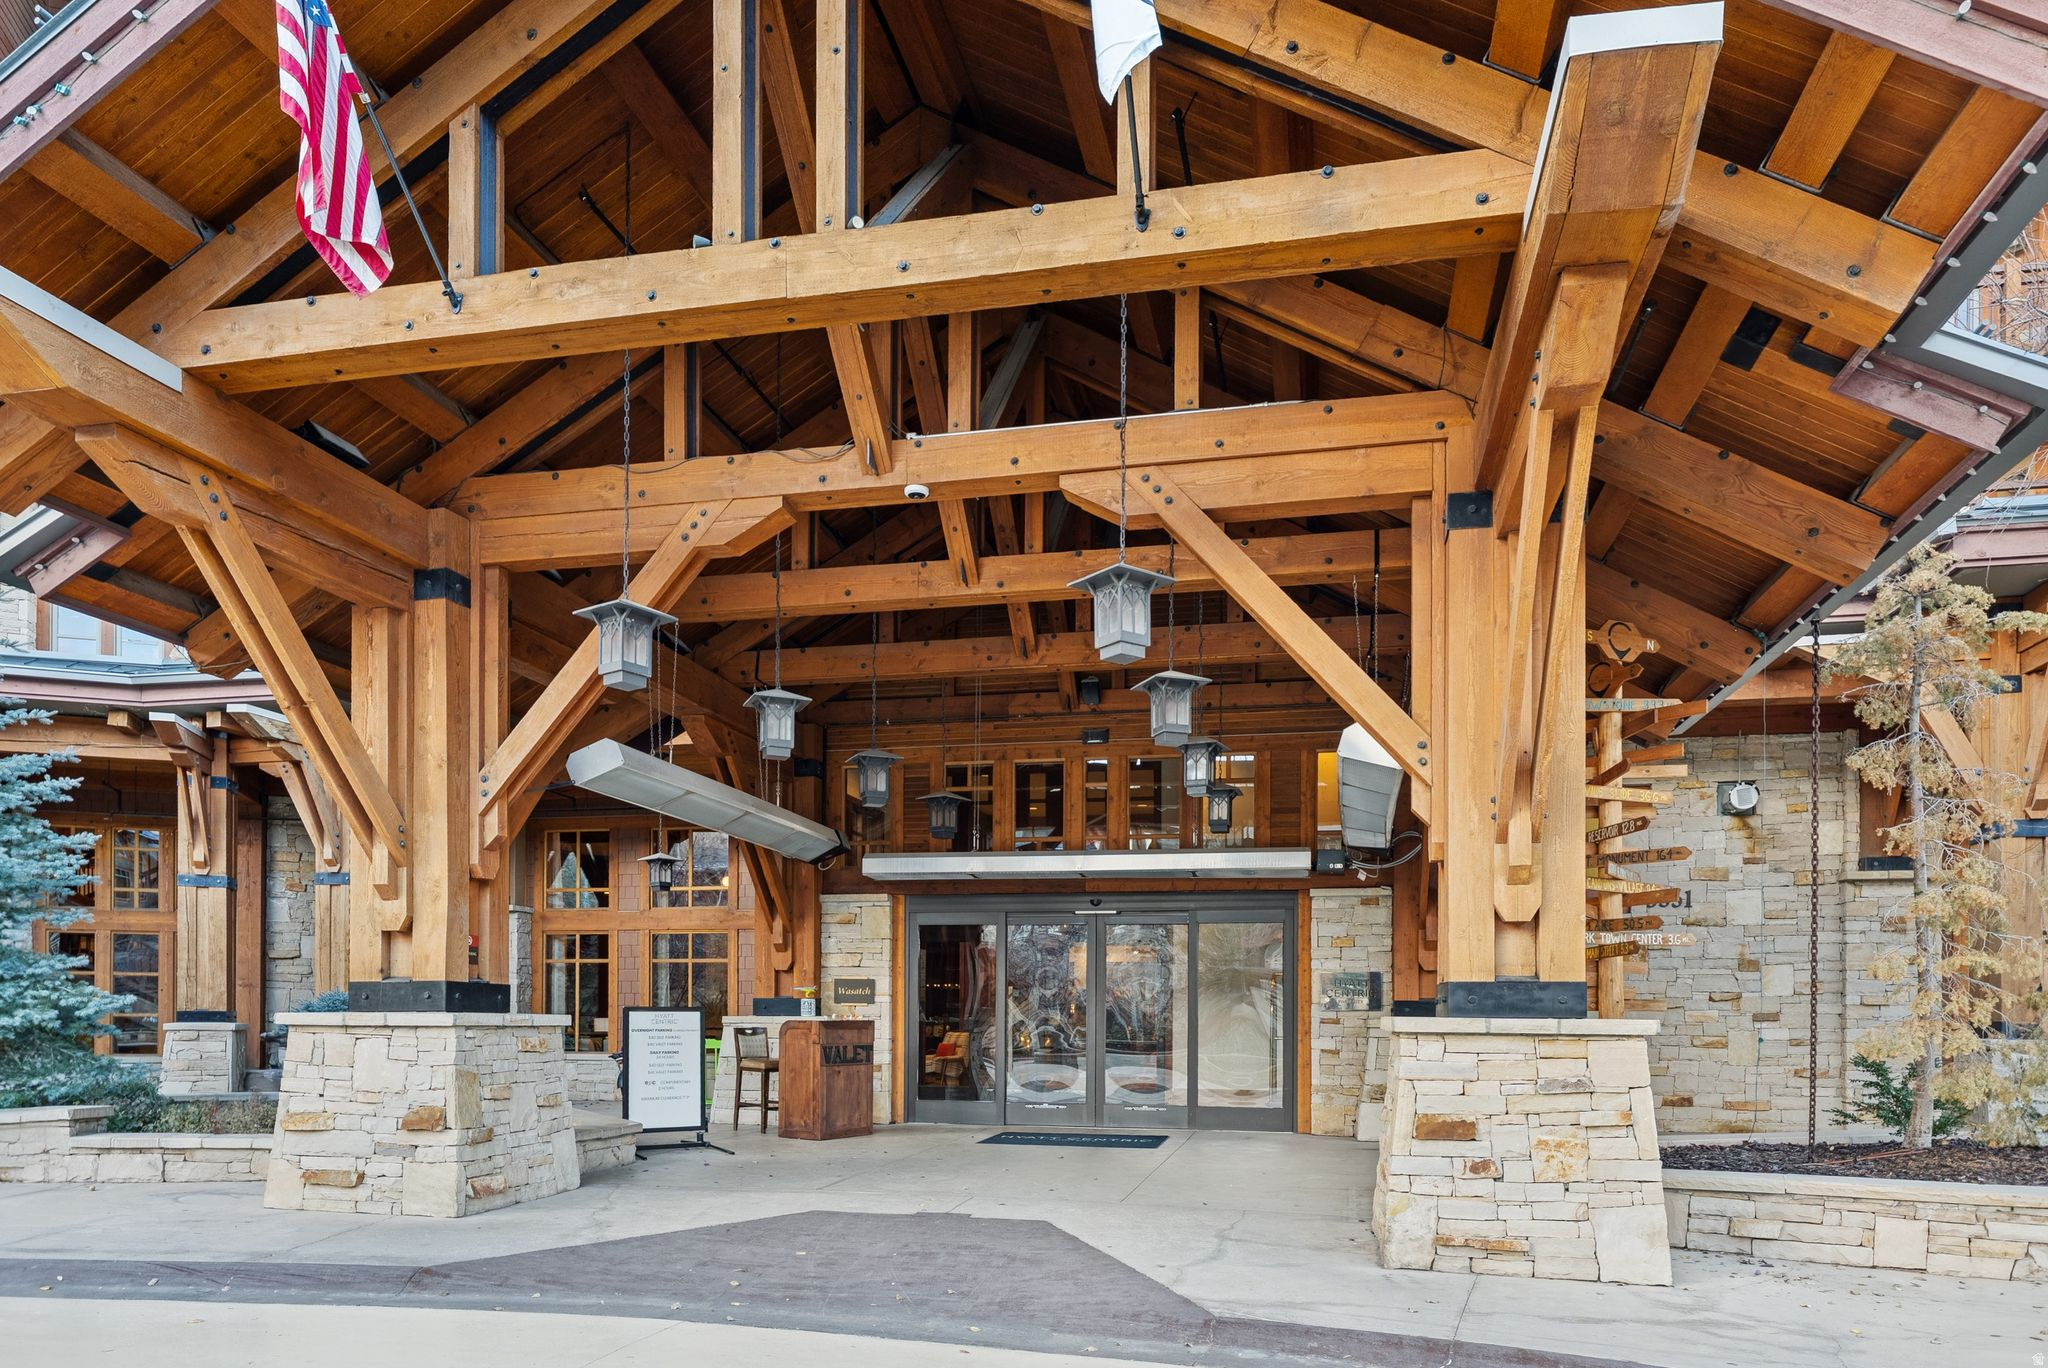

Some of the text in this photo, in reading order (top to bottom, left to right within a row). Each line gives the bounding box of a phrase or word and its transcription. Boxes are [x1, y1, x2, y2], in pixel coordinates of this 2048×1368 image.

[1646, 640, 1654, 650] N
[1588, 826, 1618, 842] RESERVOIR
[1621, 820, 1635, 834] 12.8
[1597, 851, 1649, 866] MONUMENT
[1599, 932, 1626, 944] TOWN
[1631, 933, 1663, 945] CENTER
[1334, 979, 1368, 987] HYATT
[838, 986, 871, 996] Wasatch
[1326, 989, 1376, 998] CENTRIC
[822, 1045, 873, 1064] VALET
